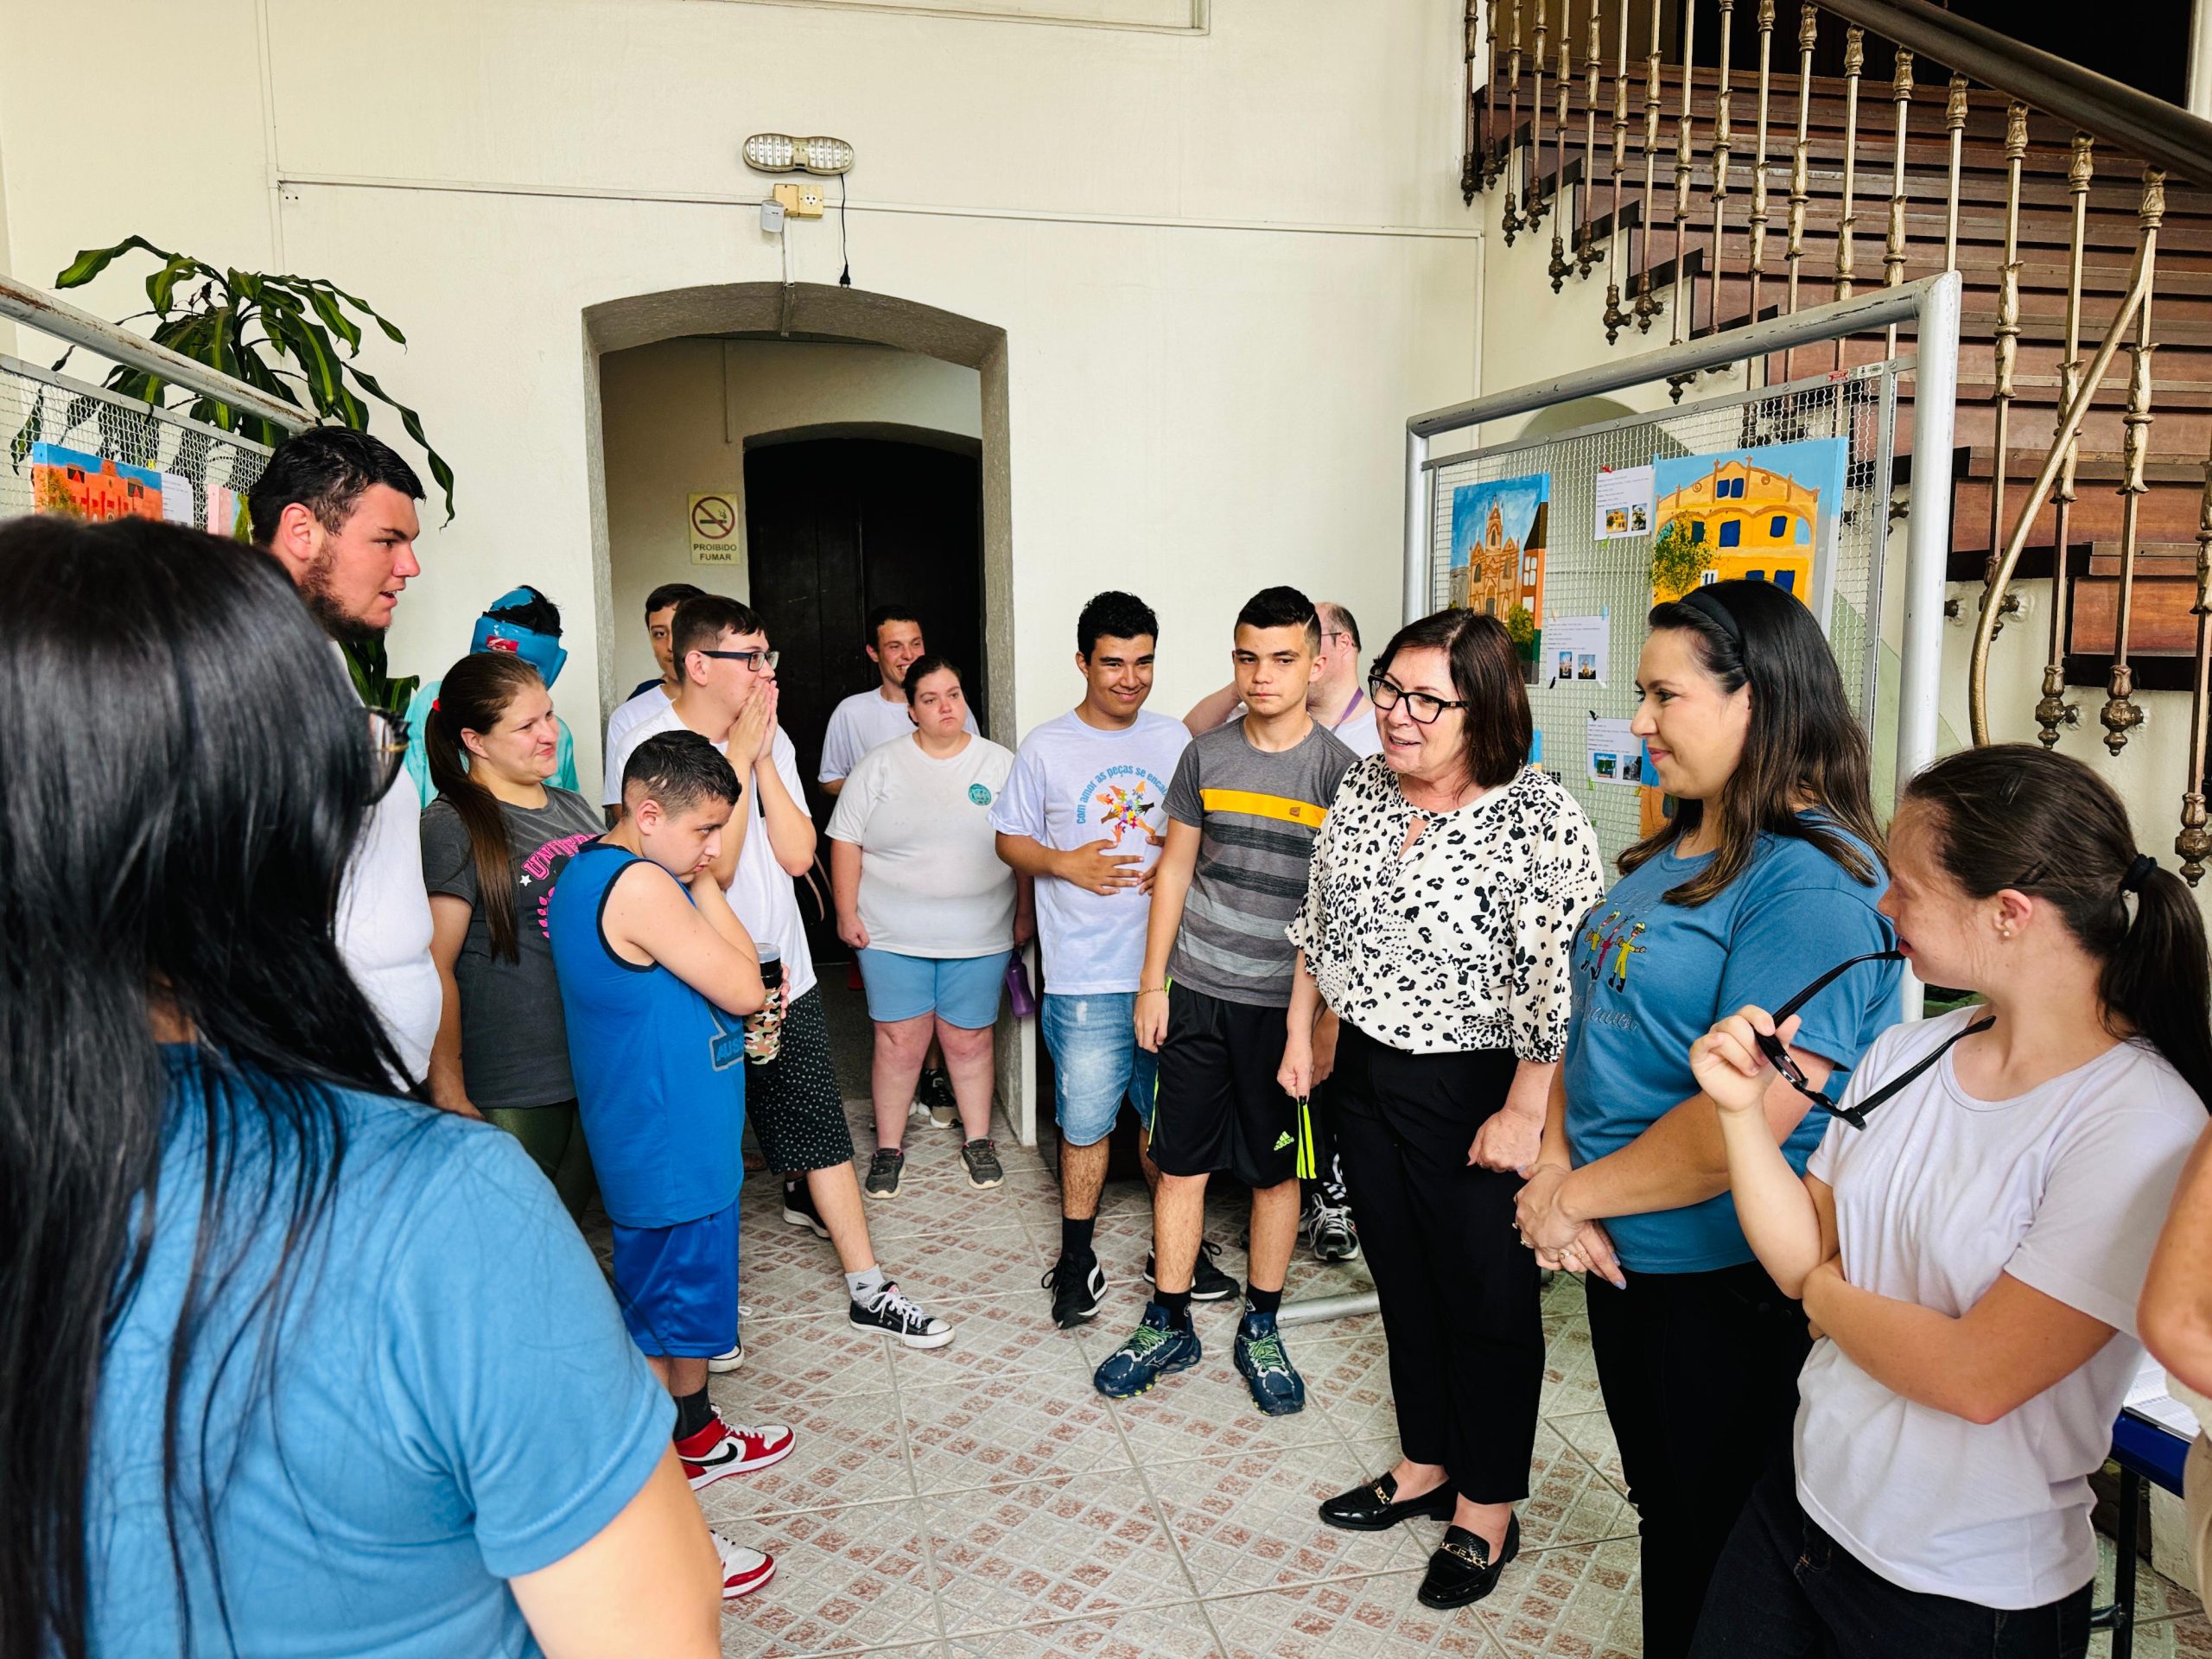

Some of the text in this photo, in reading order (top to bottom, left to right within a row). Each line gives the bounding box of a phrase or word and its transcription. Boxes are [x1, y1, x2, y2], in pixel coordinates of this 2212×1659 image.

[1076, 765, 1168, 824] com amor as peças se encai
